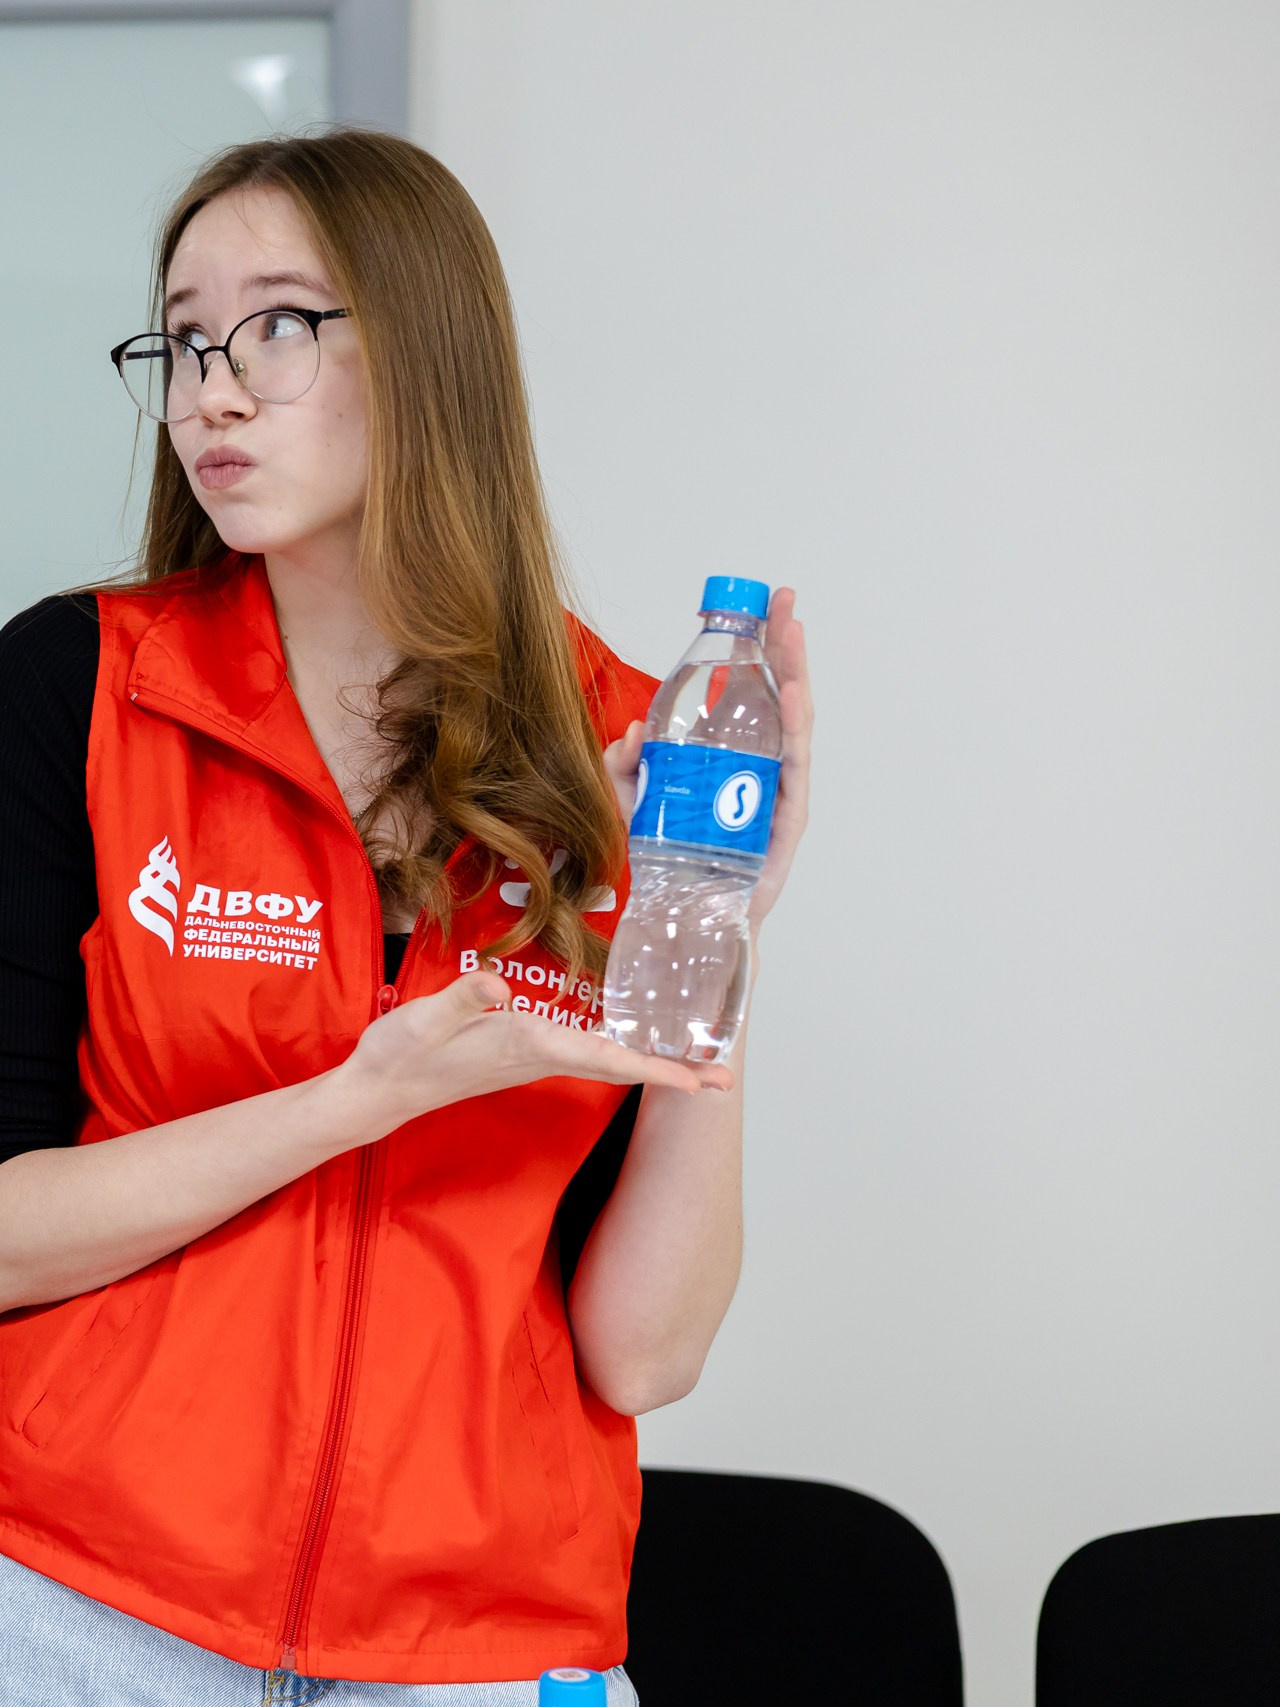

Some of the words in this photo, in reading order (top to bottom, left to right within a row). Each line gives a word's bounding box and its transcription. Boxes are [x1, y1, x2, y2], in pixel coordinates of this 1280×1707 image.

[186, 883, 323, 924] ДВФУ
[183, 928, 320, 954] ФЕДЕРАЛЬНЫЙ
[184, 915, 321, 940] ДАЛЬНЕВОСТОЧНЫЙ
[182, 943, 318, 971] УНИВЕРСИТЕТ
